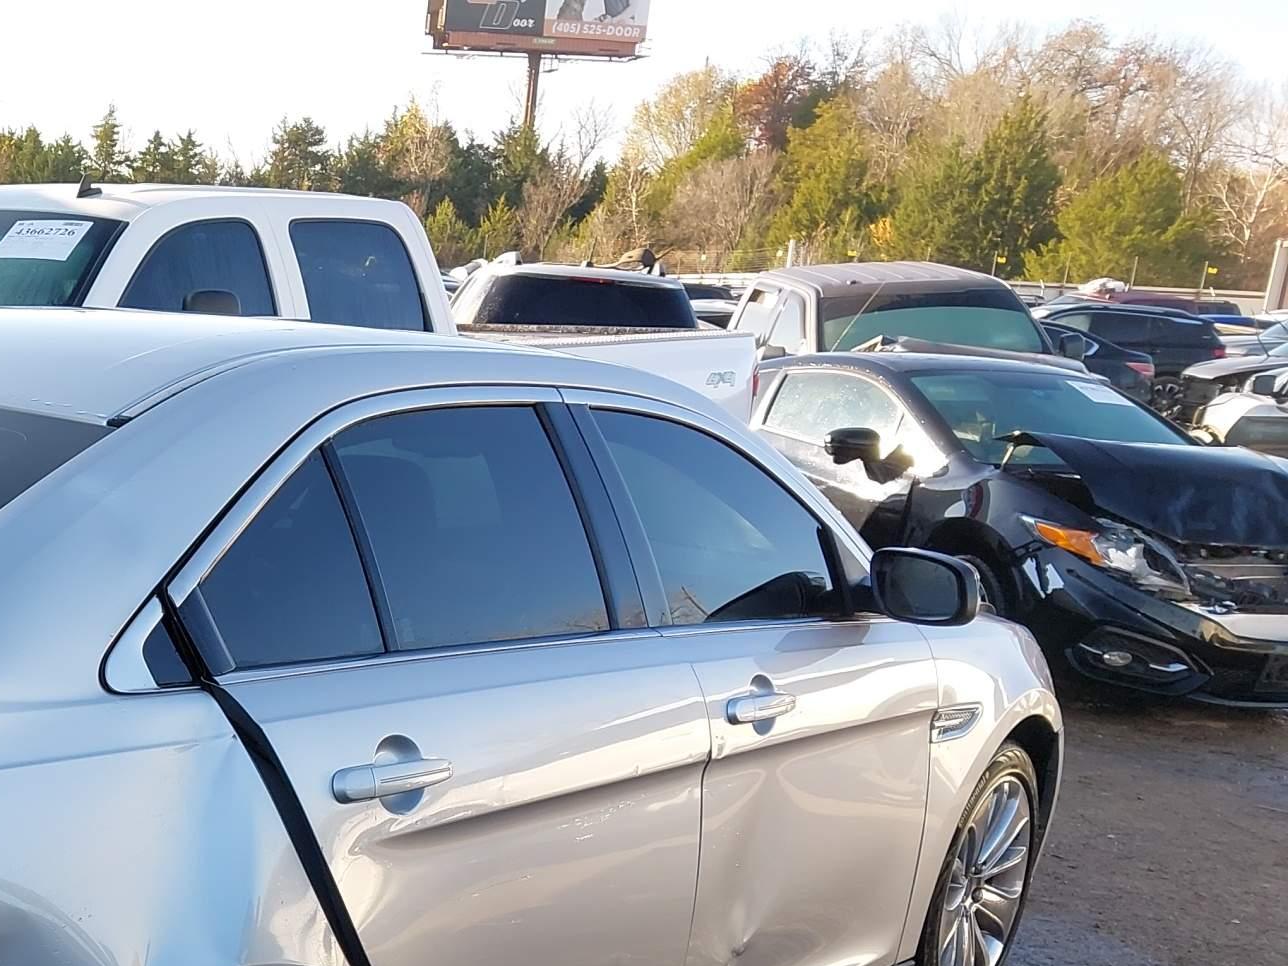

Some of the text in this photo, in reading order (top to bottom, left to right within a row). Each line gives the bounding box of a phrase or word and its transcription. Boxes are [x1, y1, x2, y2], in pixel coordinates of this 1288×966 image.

[552, 21, 641, 38] (405) 525-DOOR
[15, 227, 76, 236] 43662726
